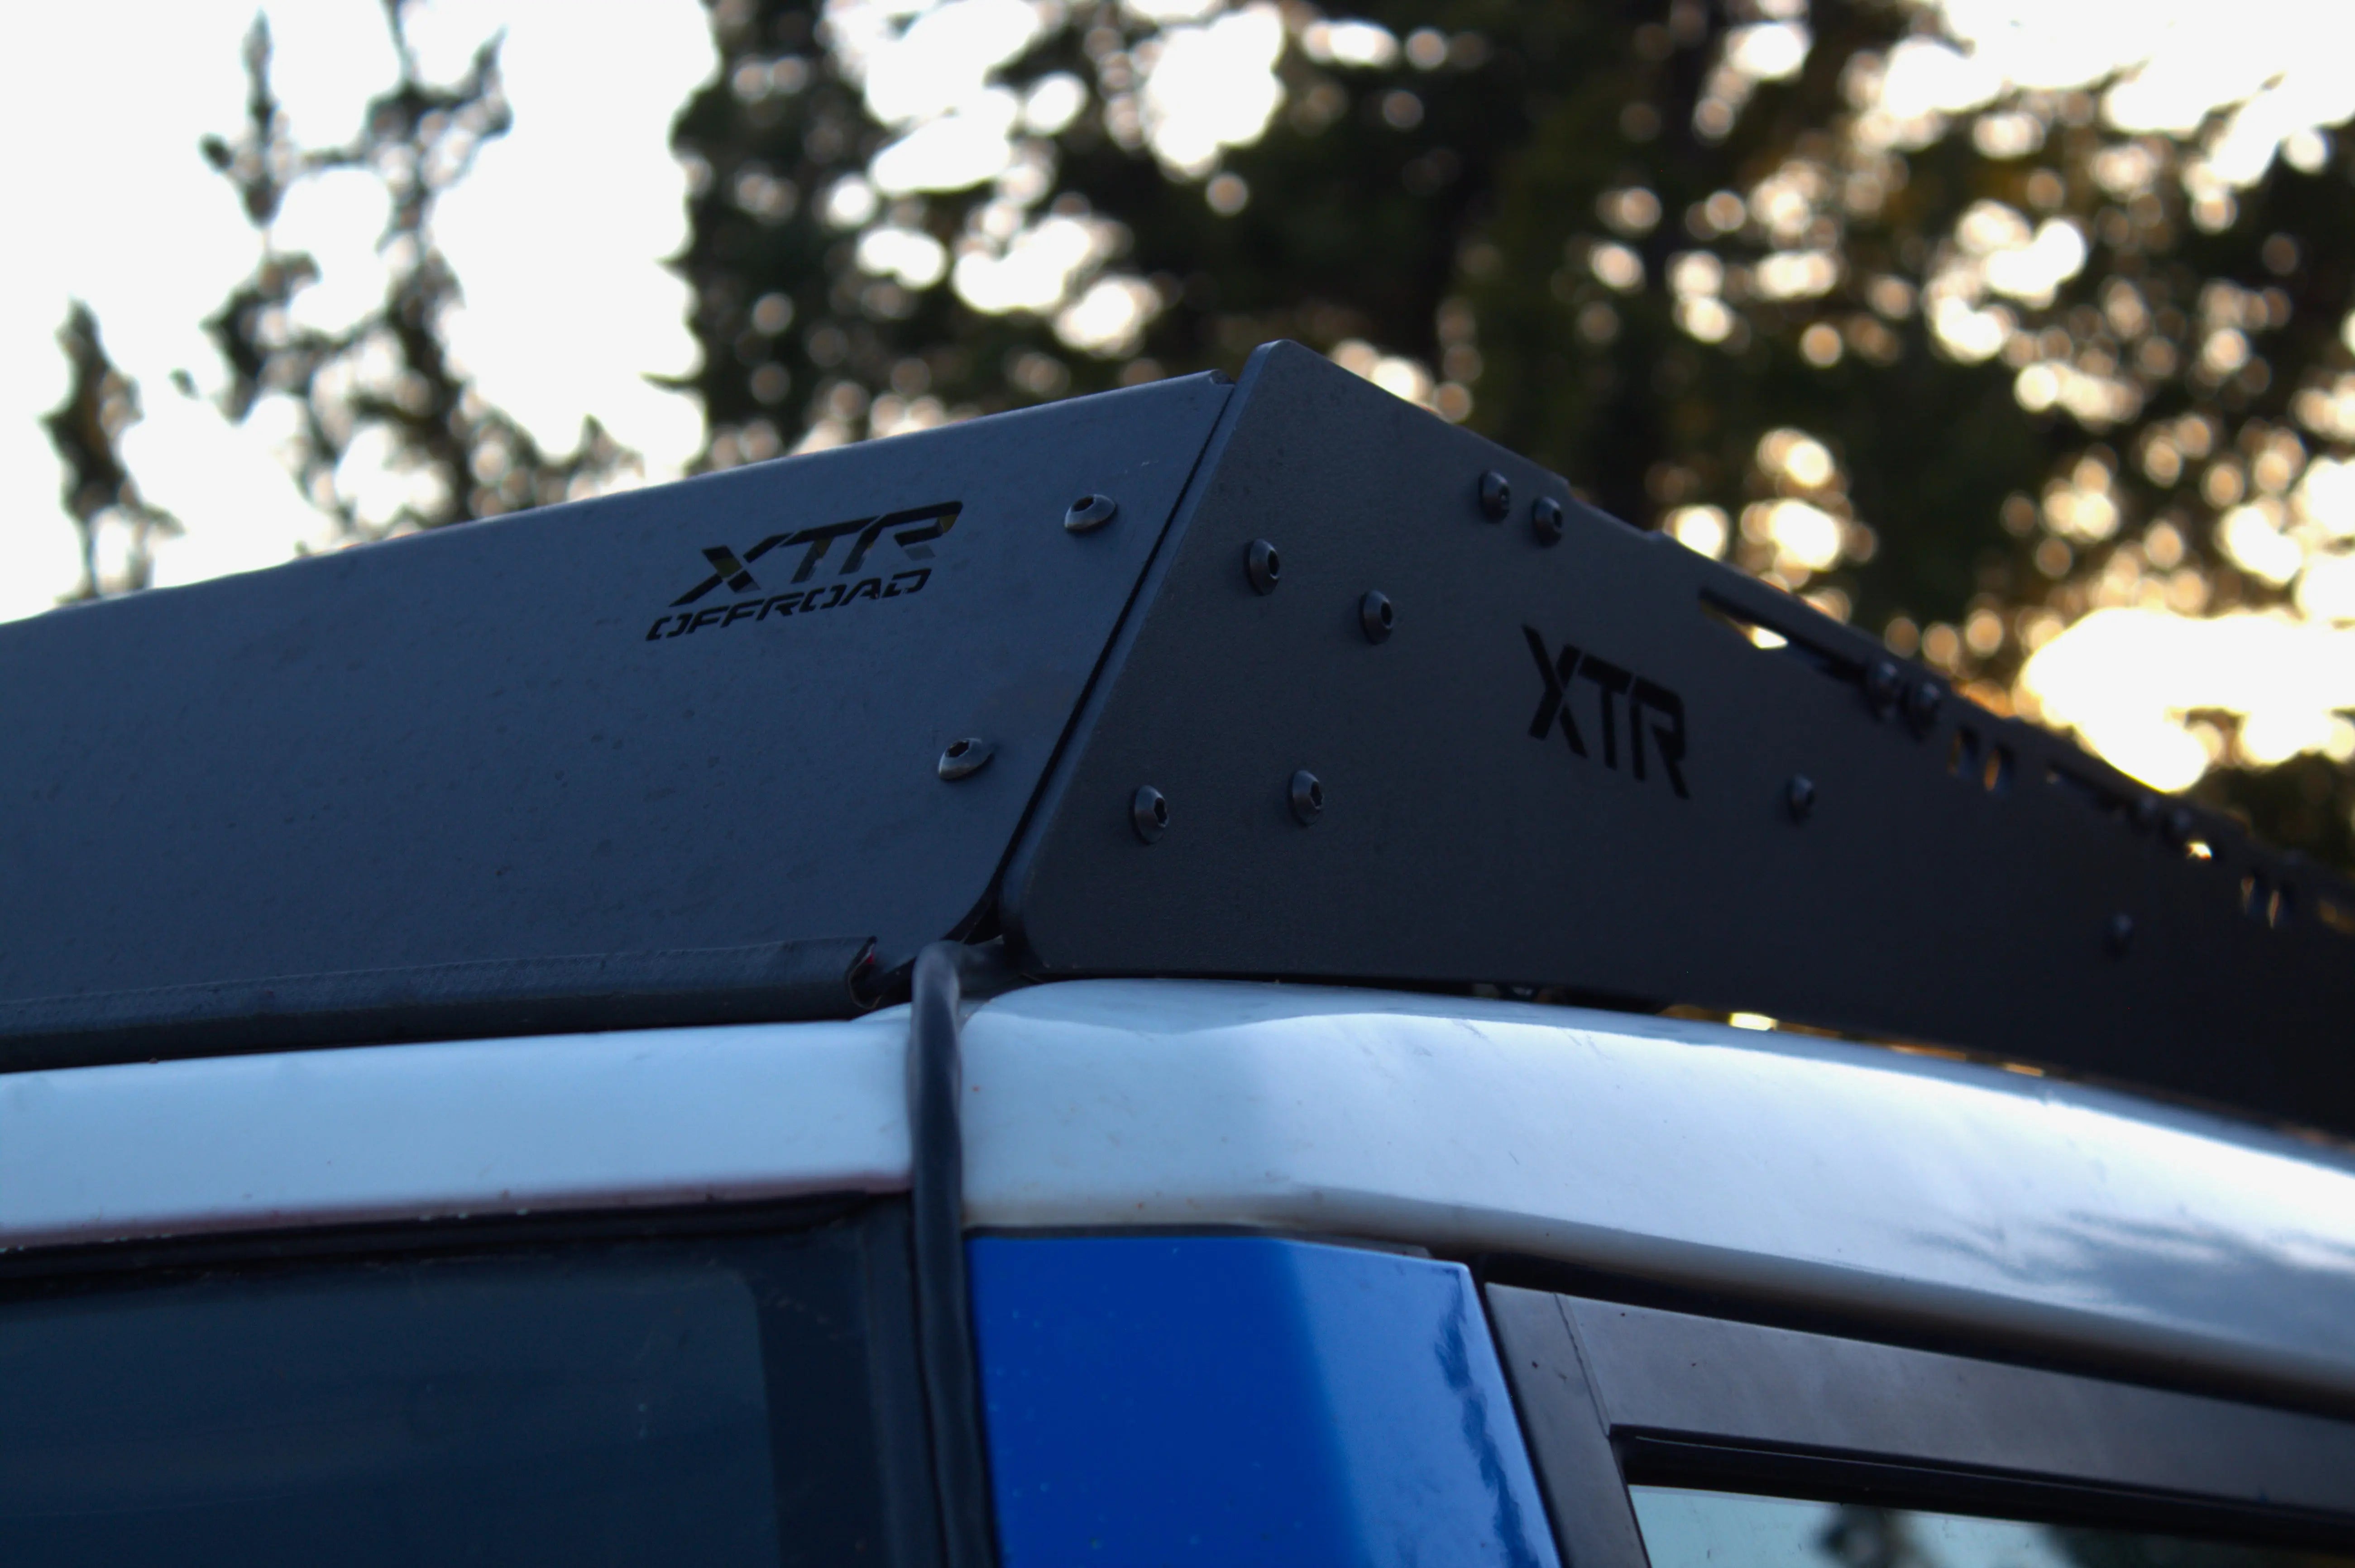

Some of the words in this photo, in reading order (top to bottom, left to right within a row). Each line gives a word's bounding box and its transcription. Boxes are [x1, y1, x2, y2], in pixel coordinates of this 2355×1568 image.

[646, 568, 932, 641] OFFROAD
[669, 501, 963, 607] XTR
[1522, 625, 1690, 799] XTR
